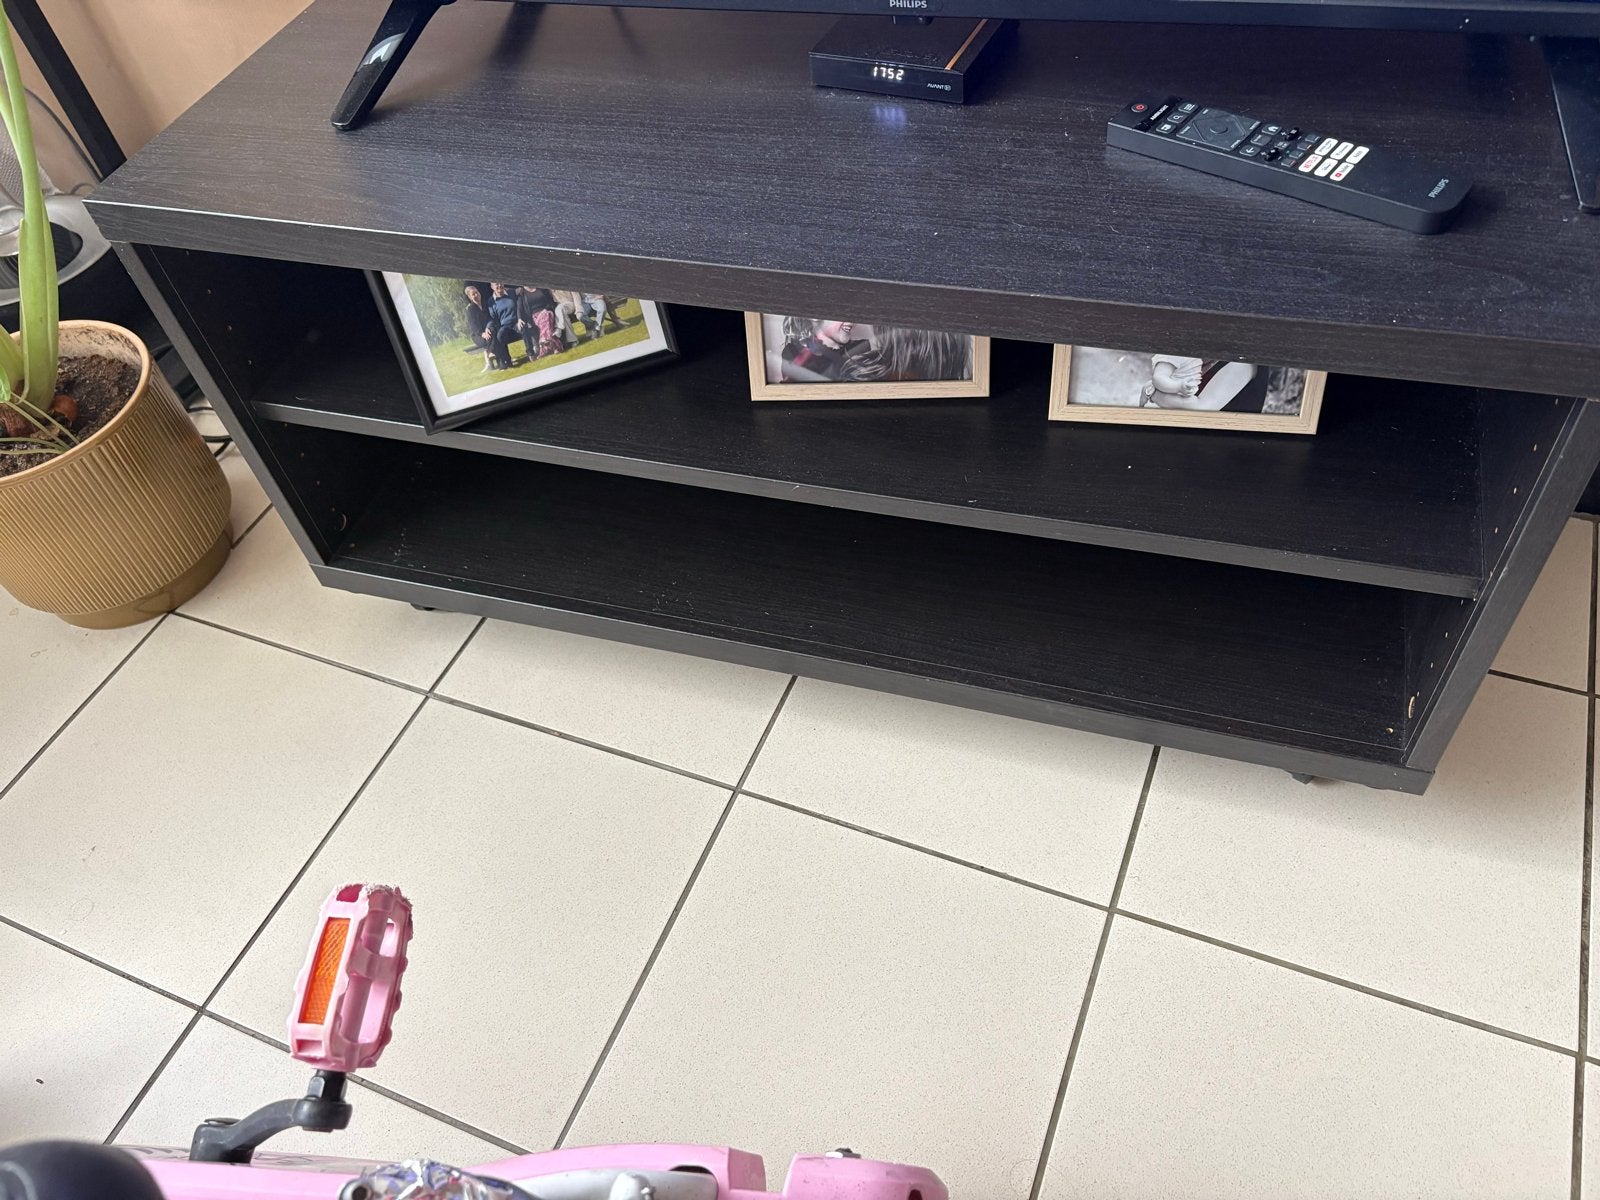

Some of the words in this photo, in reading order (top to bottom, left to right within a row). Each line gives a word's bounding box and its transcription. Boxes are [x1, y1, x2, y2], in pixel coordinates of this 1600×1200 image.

[889, 0, 927, 8] PHILIPS
[873, 66, 904, 80] 1752
[1427, 178, 1449, 198] PHILIPS
